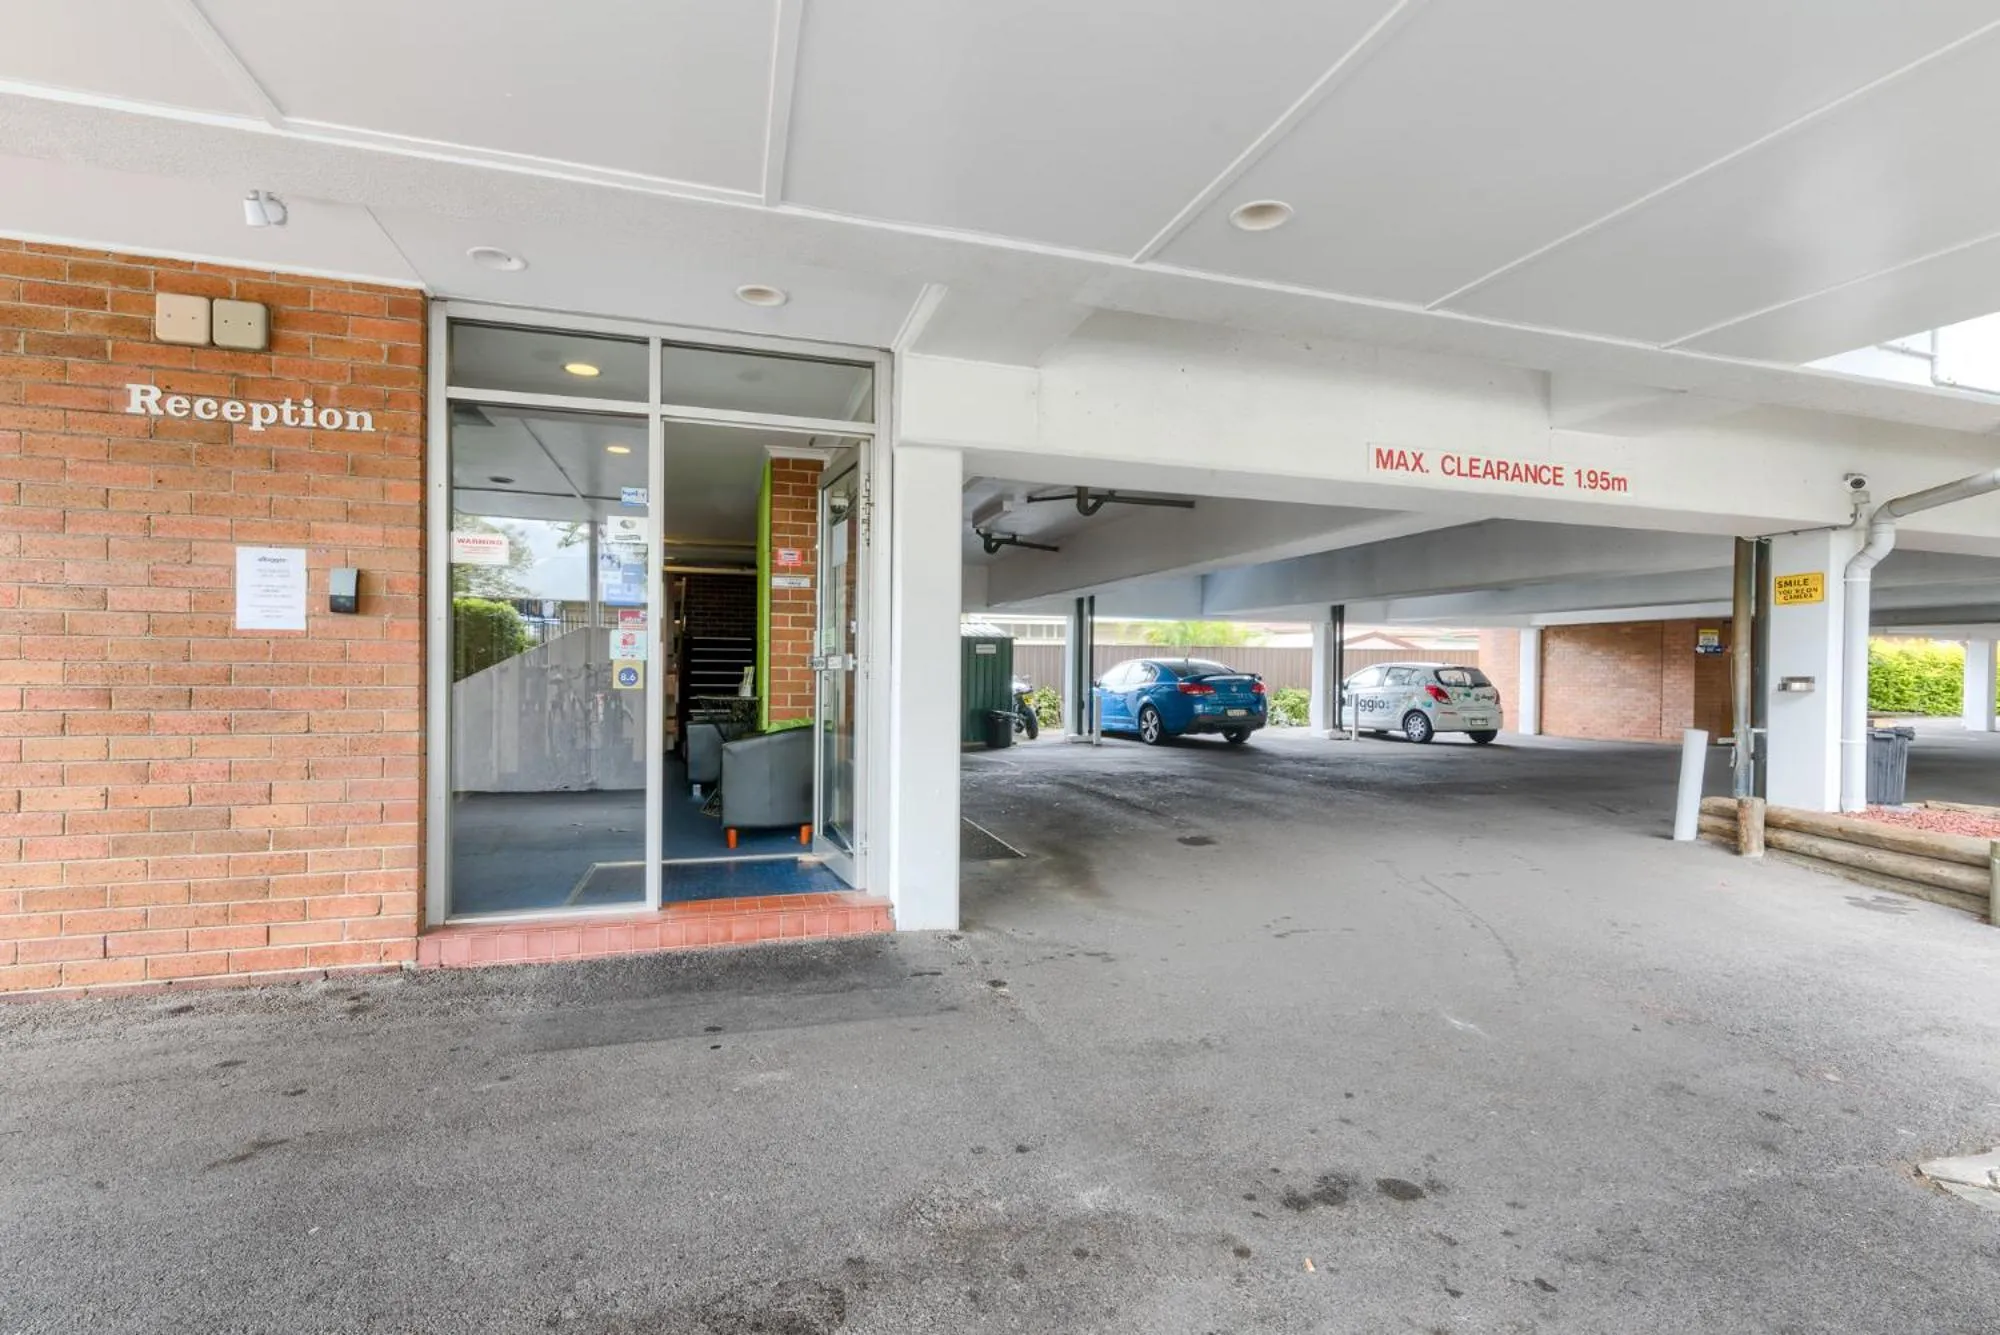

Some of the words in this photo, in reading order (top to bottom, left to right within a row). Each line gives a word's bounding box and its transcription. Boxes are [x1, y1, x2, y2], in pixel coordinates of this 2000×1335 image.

[125, 383, 376, 432] Reception
[1375, 447, 1430, 474] MAX.
[1440, 454, 1565, 487] CLEARANCE
[1574, 469, 1628, 493] 1.95m
[1776, 578, 1809, 589] SMILE
[620, 672, 637, 682] 8.6
